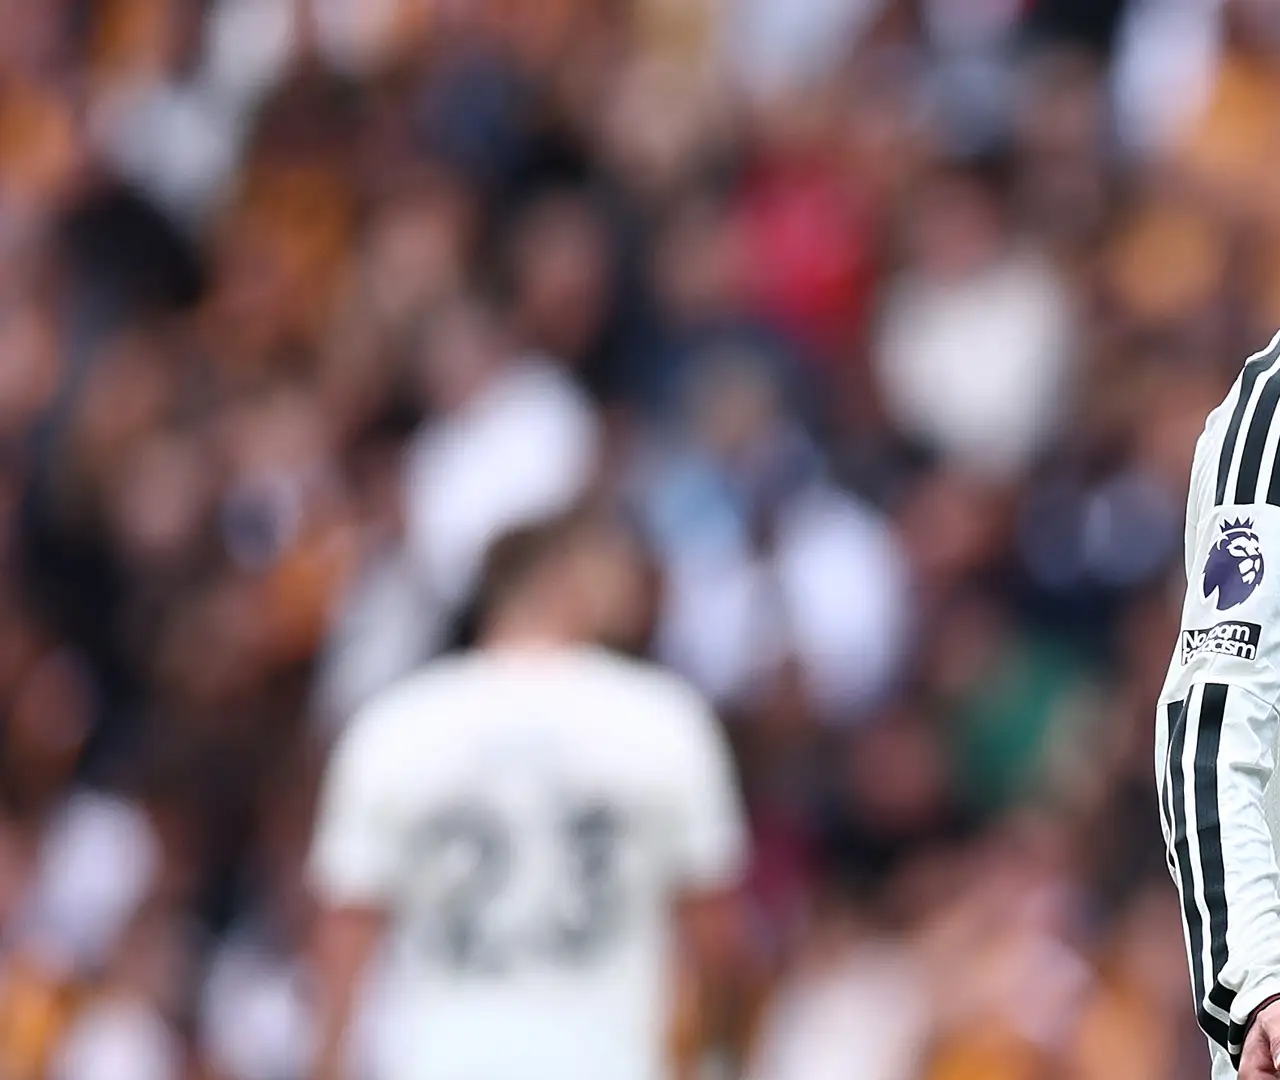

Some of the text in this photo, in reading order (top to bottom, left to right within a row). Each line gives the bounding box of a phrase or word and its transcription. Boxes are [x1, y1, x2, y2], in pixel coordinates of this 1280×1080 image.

[1183, 624, 1251, 651] No oom
[1202, 638, 1256, 661] acism
